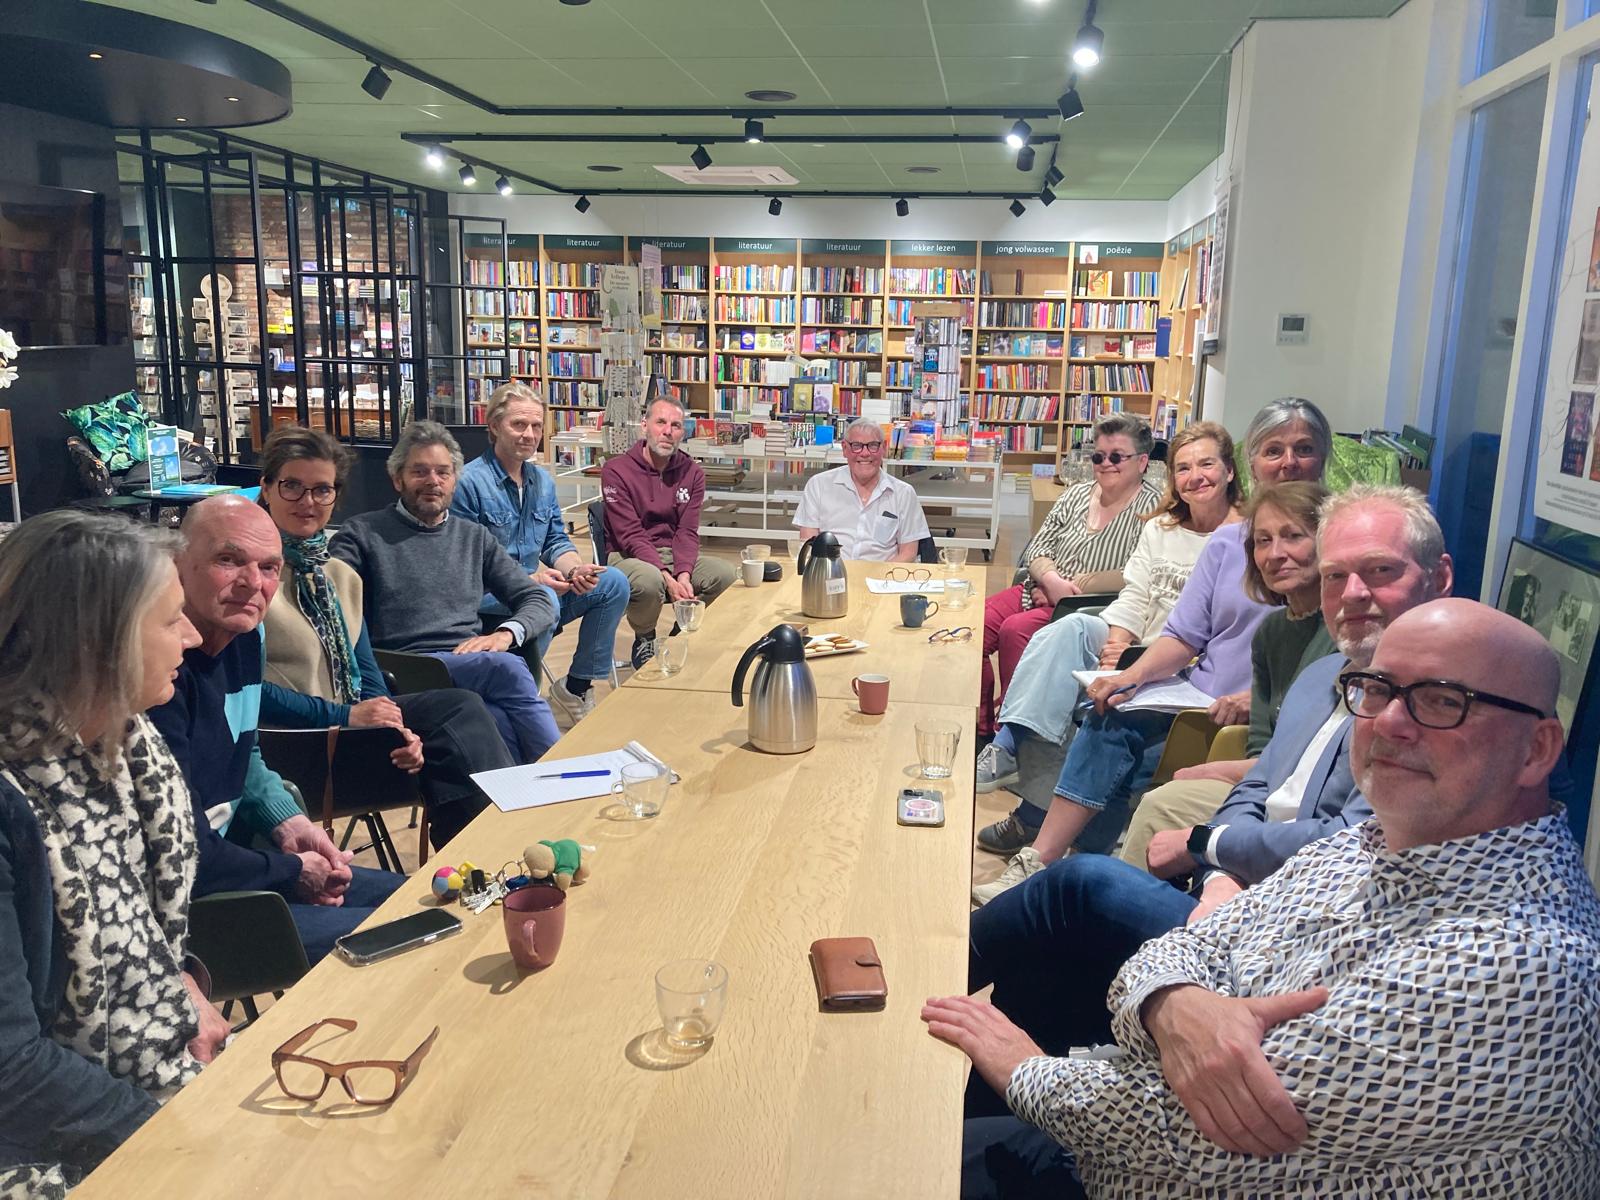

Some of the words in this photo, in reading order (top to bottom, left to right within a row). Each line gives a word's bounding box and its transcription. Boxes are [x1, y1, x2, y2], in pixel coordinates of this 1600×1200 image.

[483, 236, 516, 245] literaur
[566, 238, 601, 247] literatuur
[738, 241, 773, 250] literatuur
[826, 242, 861, 251] literatuur
[911, 243, 935, 252] lekker
[936, 243, 956, 252] lezen
[995, 244, 1013, 255] jong
[1014, 245, 1055, 253] volwassen
[1105, 245, 1132, 255] poëzie
